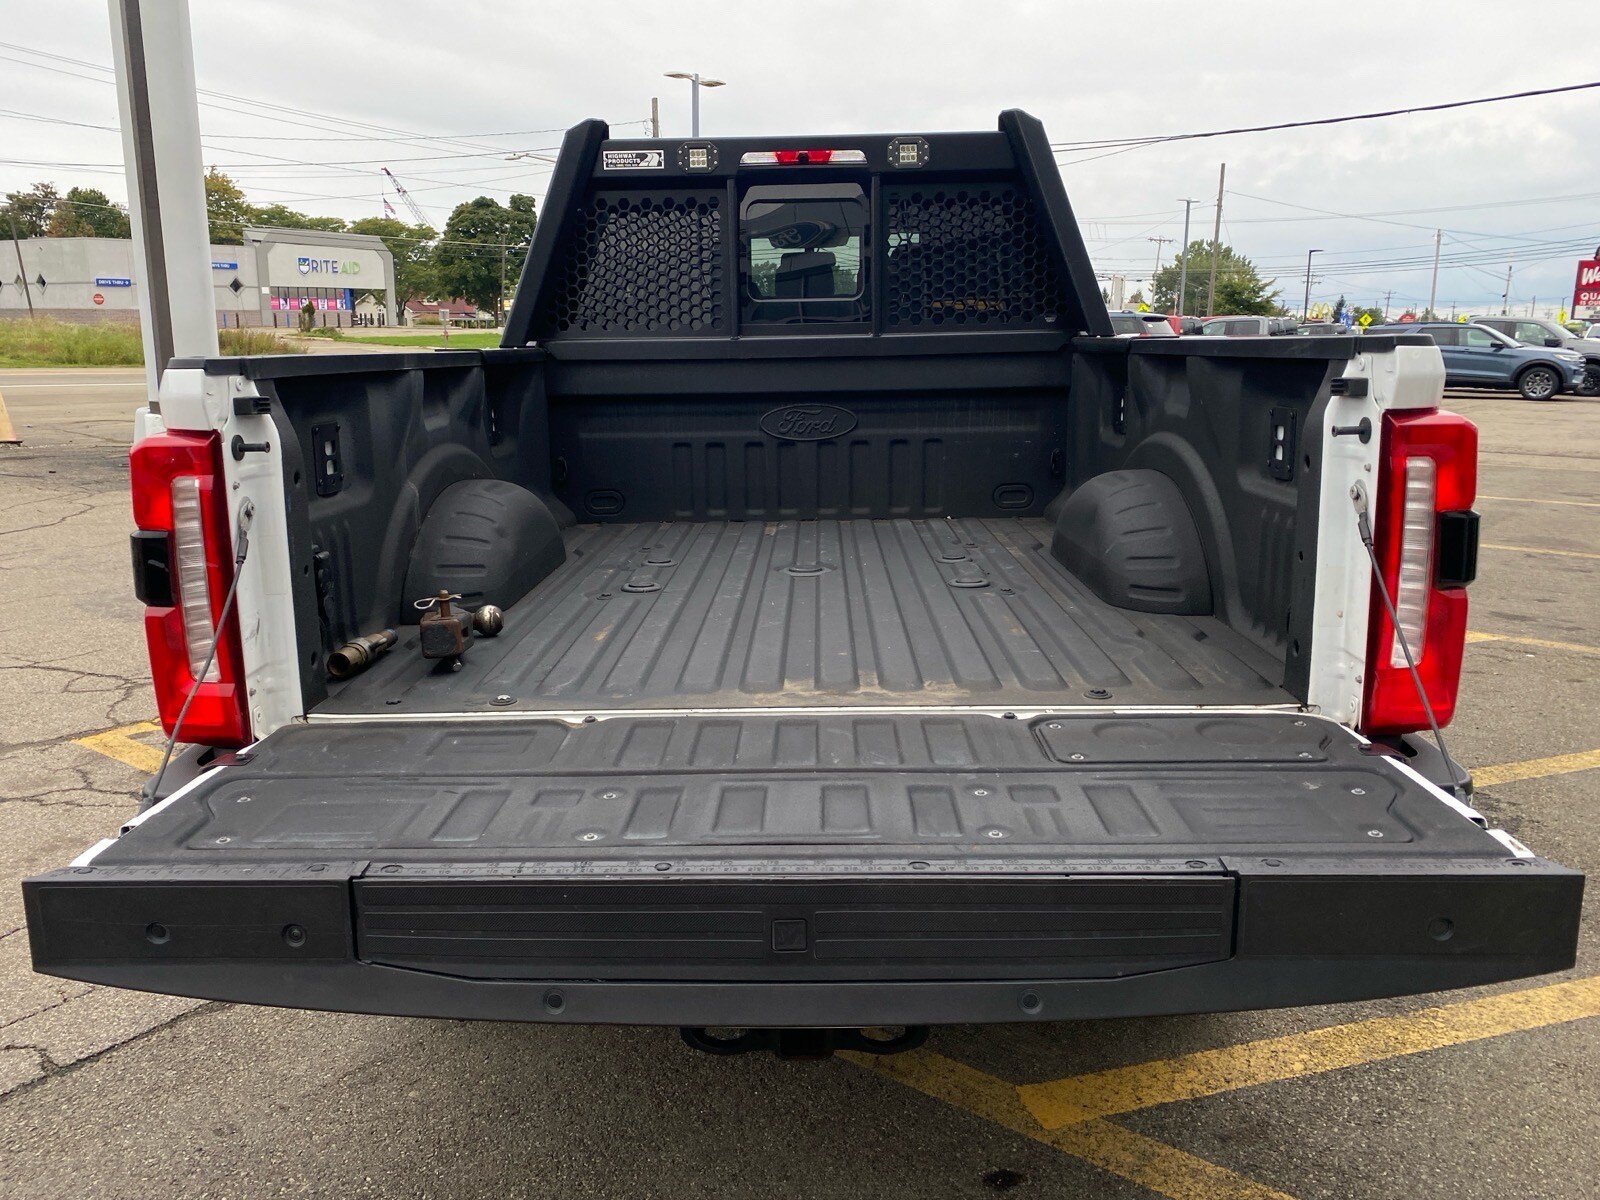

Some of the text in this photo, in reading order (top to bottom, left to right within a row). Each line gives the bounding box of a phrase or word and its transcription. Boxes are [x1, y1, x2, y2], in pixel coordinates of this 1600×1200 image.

[311, 259, 360, 274] RITE AID
[778, 409, 839, 434] Ford
